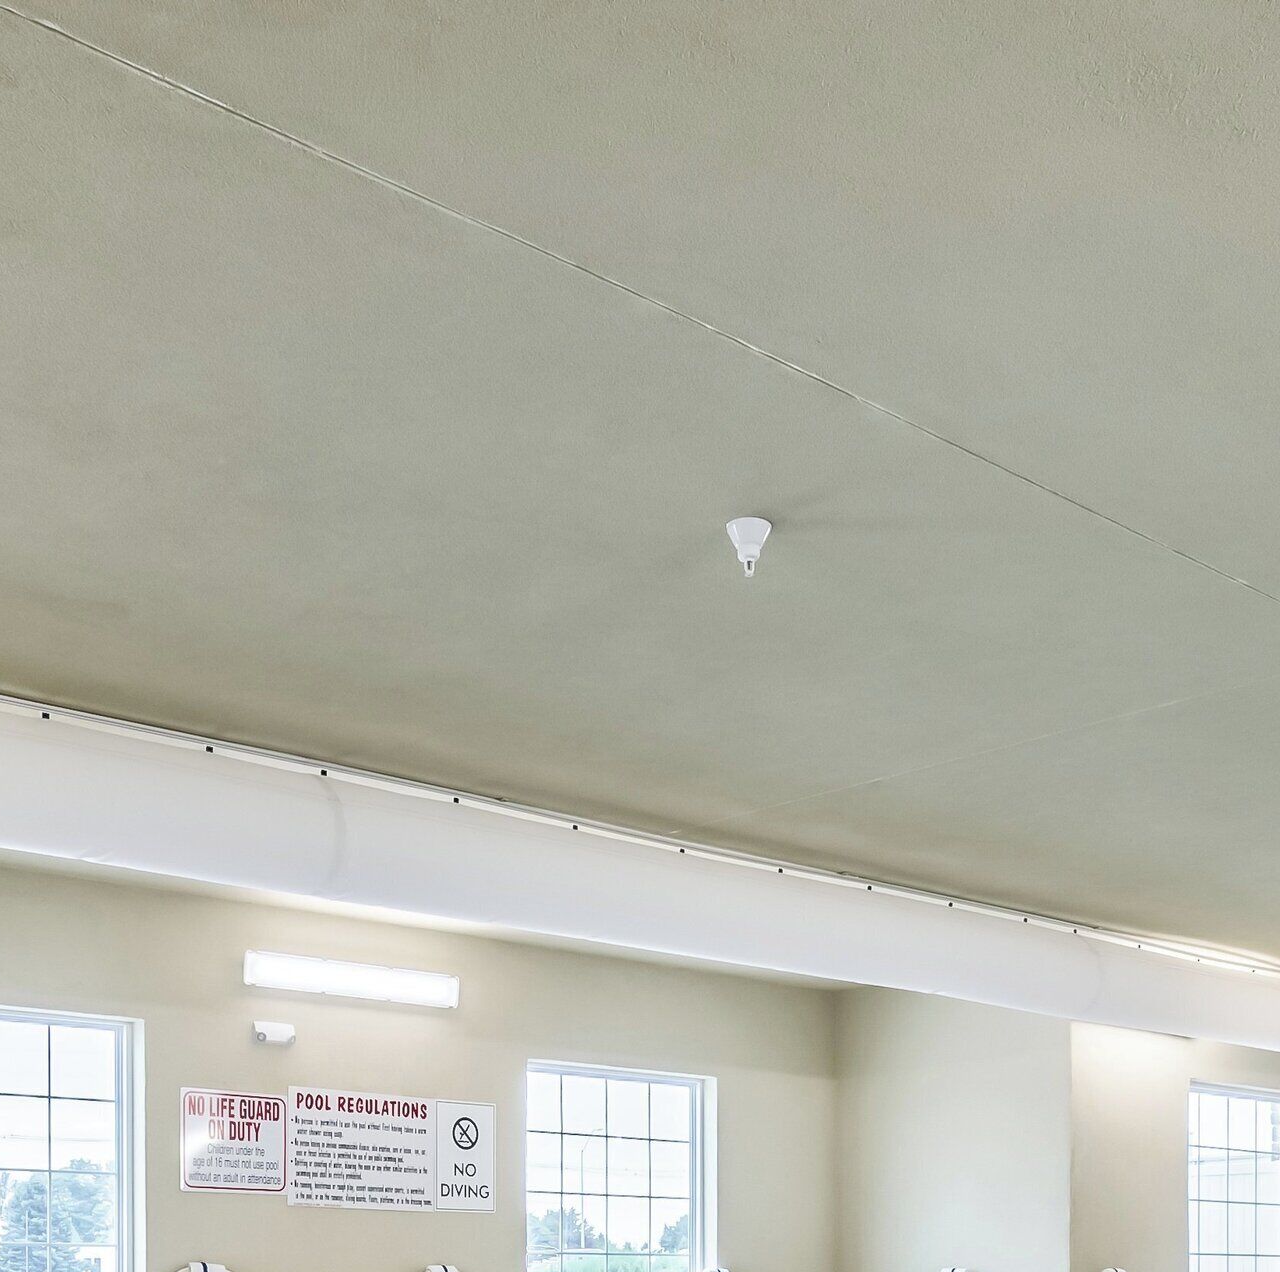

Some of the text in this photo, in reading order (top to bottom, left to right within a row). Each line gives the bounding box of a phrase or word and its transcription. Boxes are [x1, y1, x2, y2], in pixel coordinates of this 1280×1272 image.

[188, 1095, 280, 1122] NO LIFE GUARD
[296, 1092, 428, 1120] POOL REGULATIONS
[208, 1119, 261, 1142] ON DUTY
[454, 1163, 477, 1177] NO
[441, 1183, 490, 1199] DIVING
